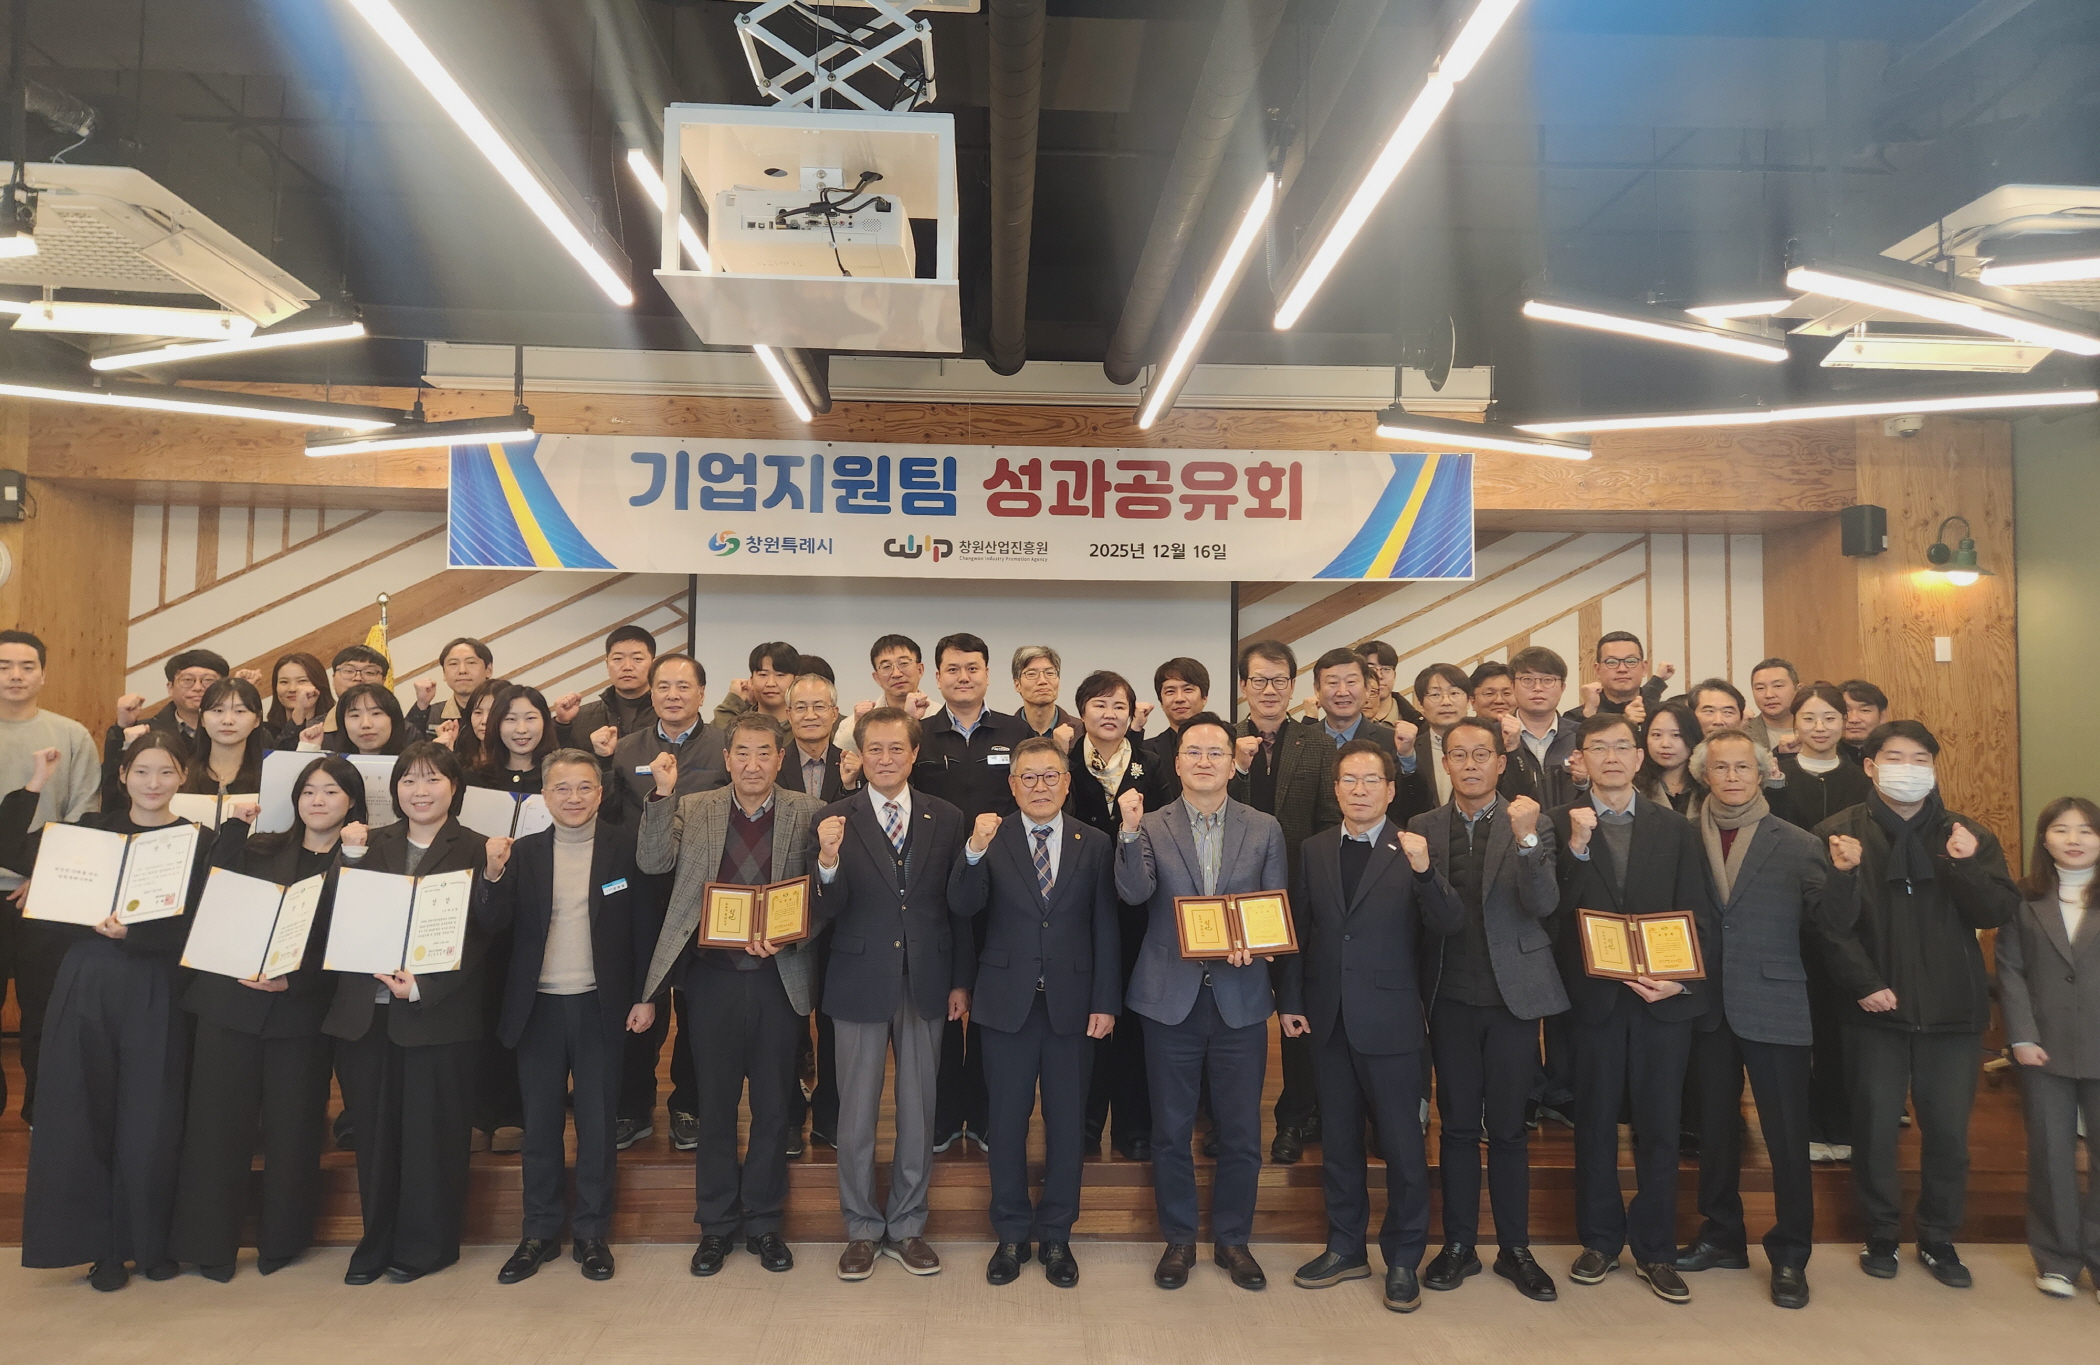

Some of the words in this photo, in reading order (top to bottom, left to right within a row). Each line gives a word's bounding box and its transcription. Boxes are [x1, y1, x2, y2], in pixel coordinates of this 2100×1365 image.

[628, 450, 957, 516] 기업지원팀
[983, 457, 1303, 521] 성과공유회
[746, 535, 833, 555] 창원특례시
[958, 540, 1048, 555] 창원산업진흥원
[1089, 543, 1145, 559] 2025년
[1152, 543, 1186, 560] 12월
[1193, 543, 1227, 560] 16일
